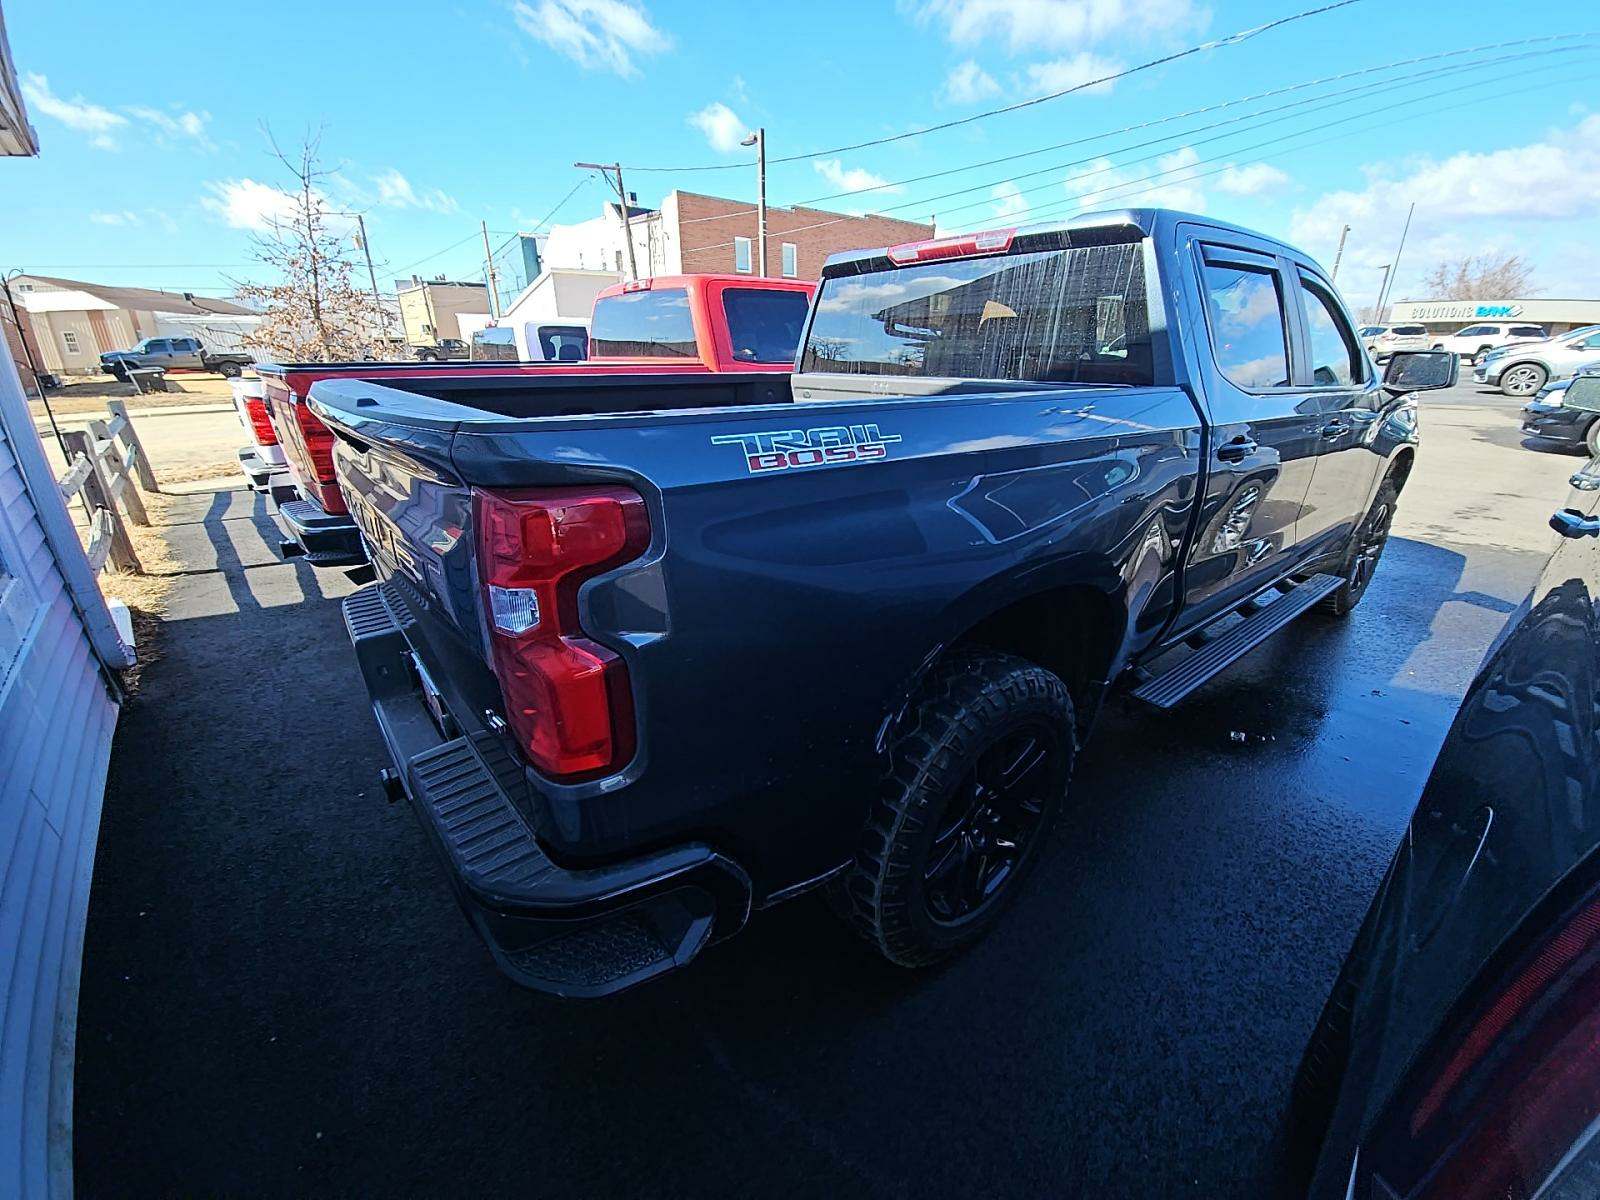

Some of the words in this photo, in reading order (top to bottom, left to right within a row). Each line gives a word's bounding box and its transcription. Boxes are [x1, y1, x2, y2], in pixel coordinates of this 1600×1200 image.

[1411, 304, 1473, 319] SOLUTIONS
[1475, 305, 1512, 317] BANK
[711, 424, 902, 455] TRAIL
[748, 442, 887, 473] BOSS
